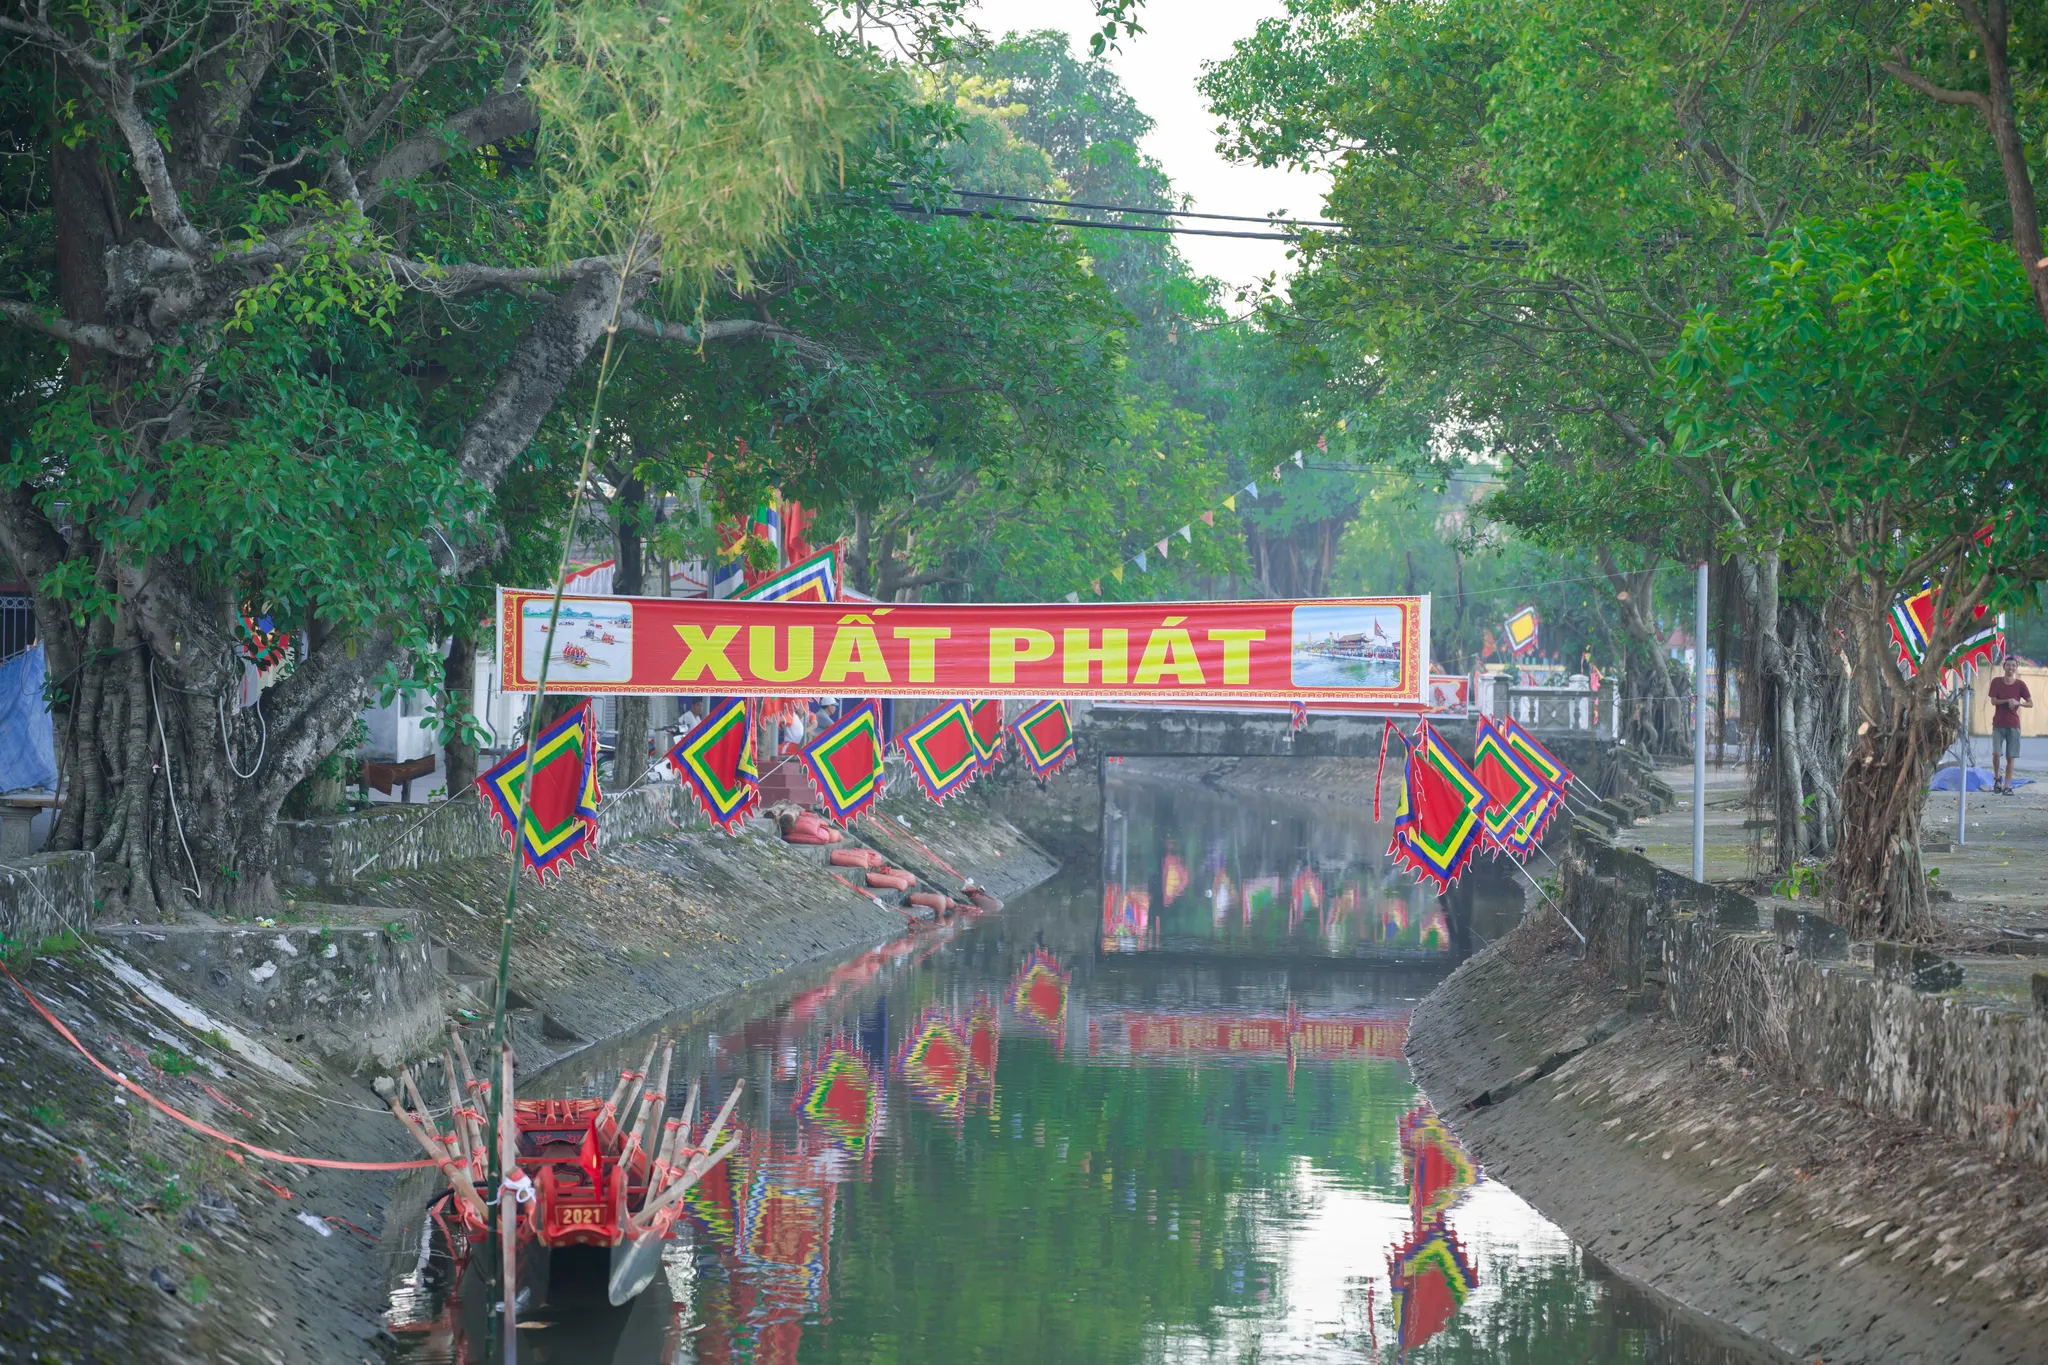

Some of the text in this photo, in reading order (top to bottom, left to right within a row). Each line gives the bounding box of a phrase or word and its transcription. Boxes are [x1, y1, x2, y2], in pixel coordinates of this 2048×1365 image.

[672, 608, 1266, 684] XUẤT PHÁT
[562, 1208, 600, 1224] 2021
